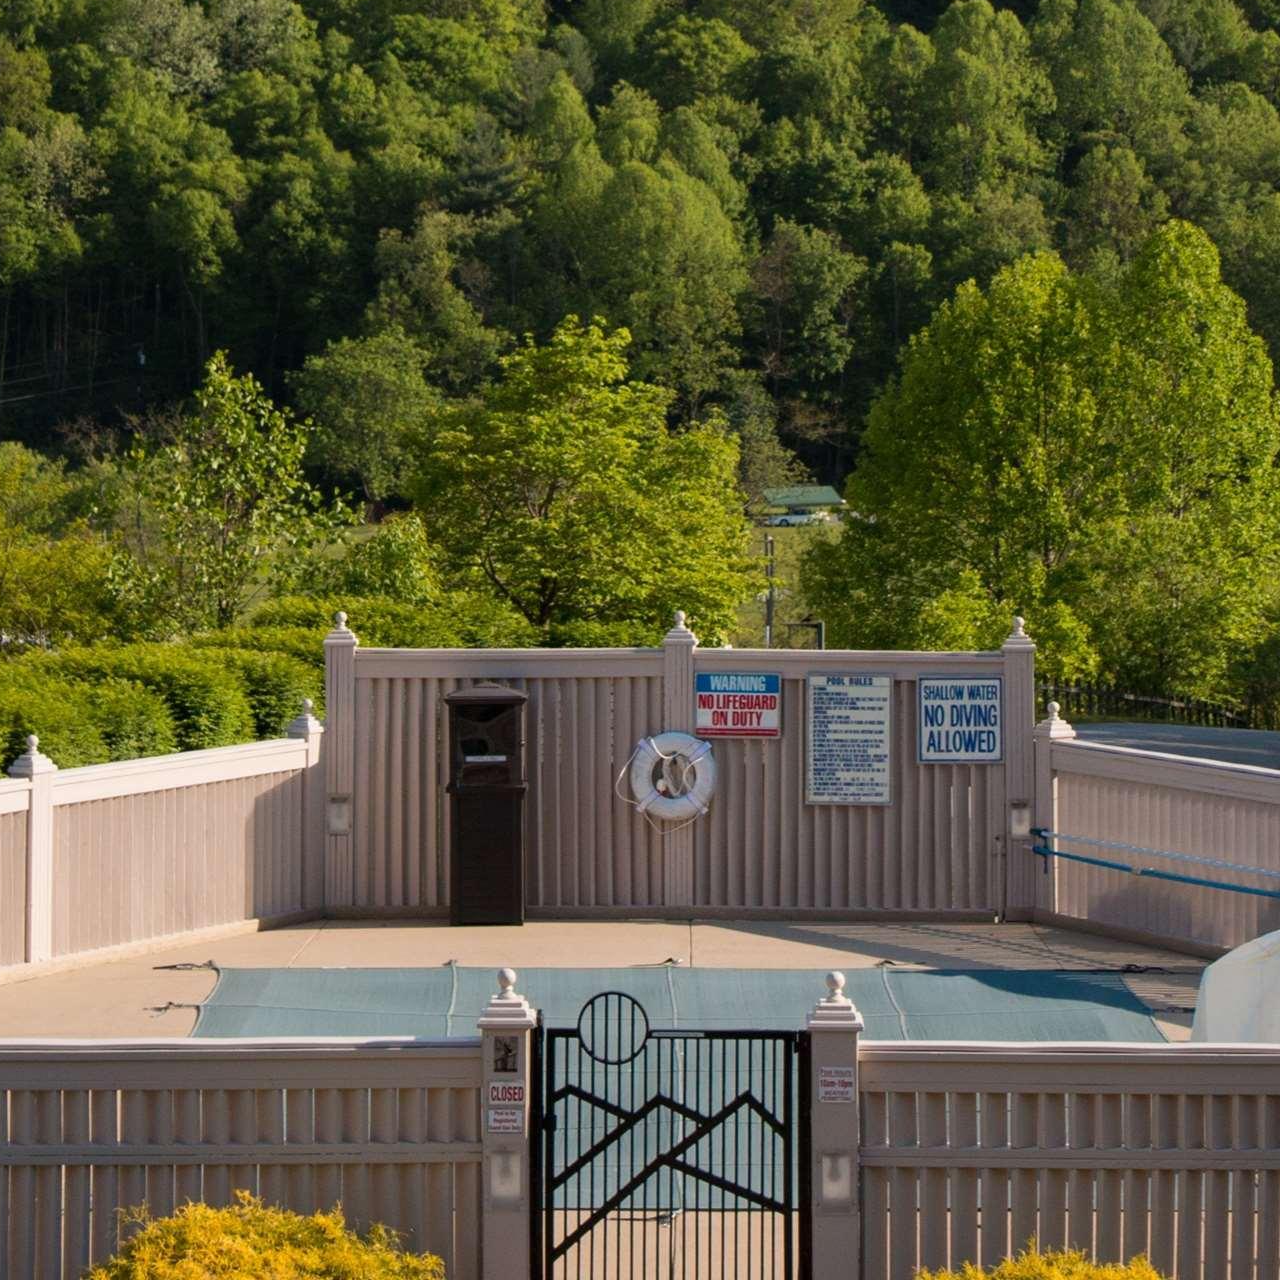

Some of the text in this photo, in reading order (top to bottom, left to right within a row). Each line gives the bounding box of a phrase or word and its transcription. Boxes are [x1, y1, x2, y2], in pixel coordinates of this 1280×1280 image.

[710, 675, 767, 692] WARNING
[826, 677, 873, 686] POOL RULES
[923, 685, 998, 700] SHALLOW WATER
[698, 694, 777, 710] NO LIFEGUARD
[712, 711, 763, 726] ON DUTY
[924, 704, 998, 727] NO DIVING
[927, 730, 996, 753] ALLOWED
[491, 1086, 524, 1101] CLOSED
